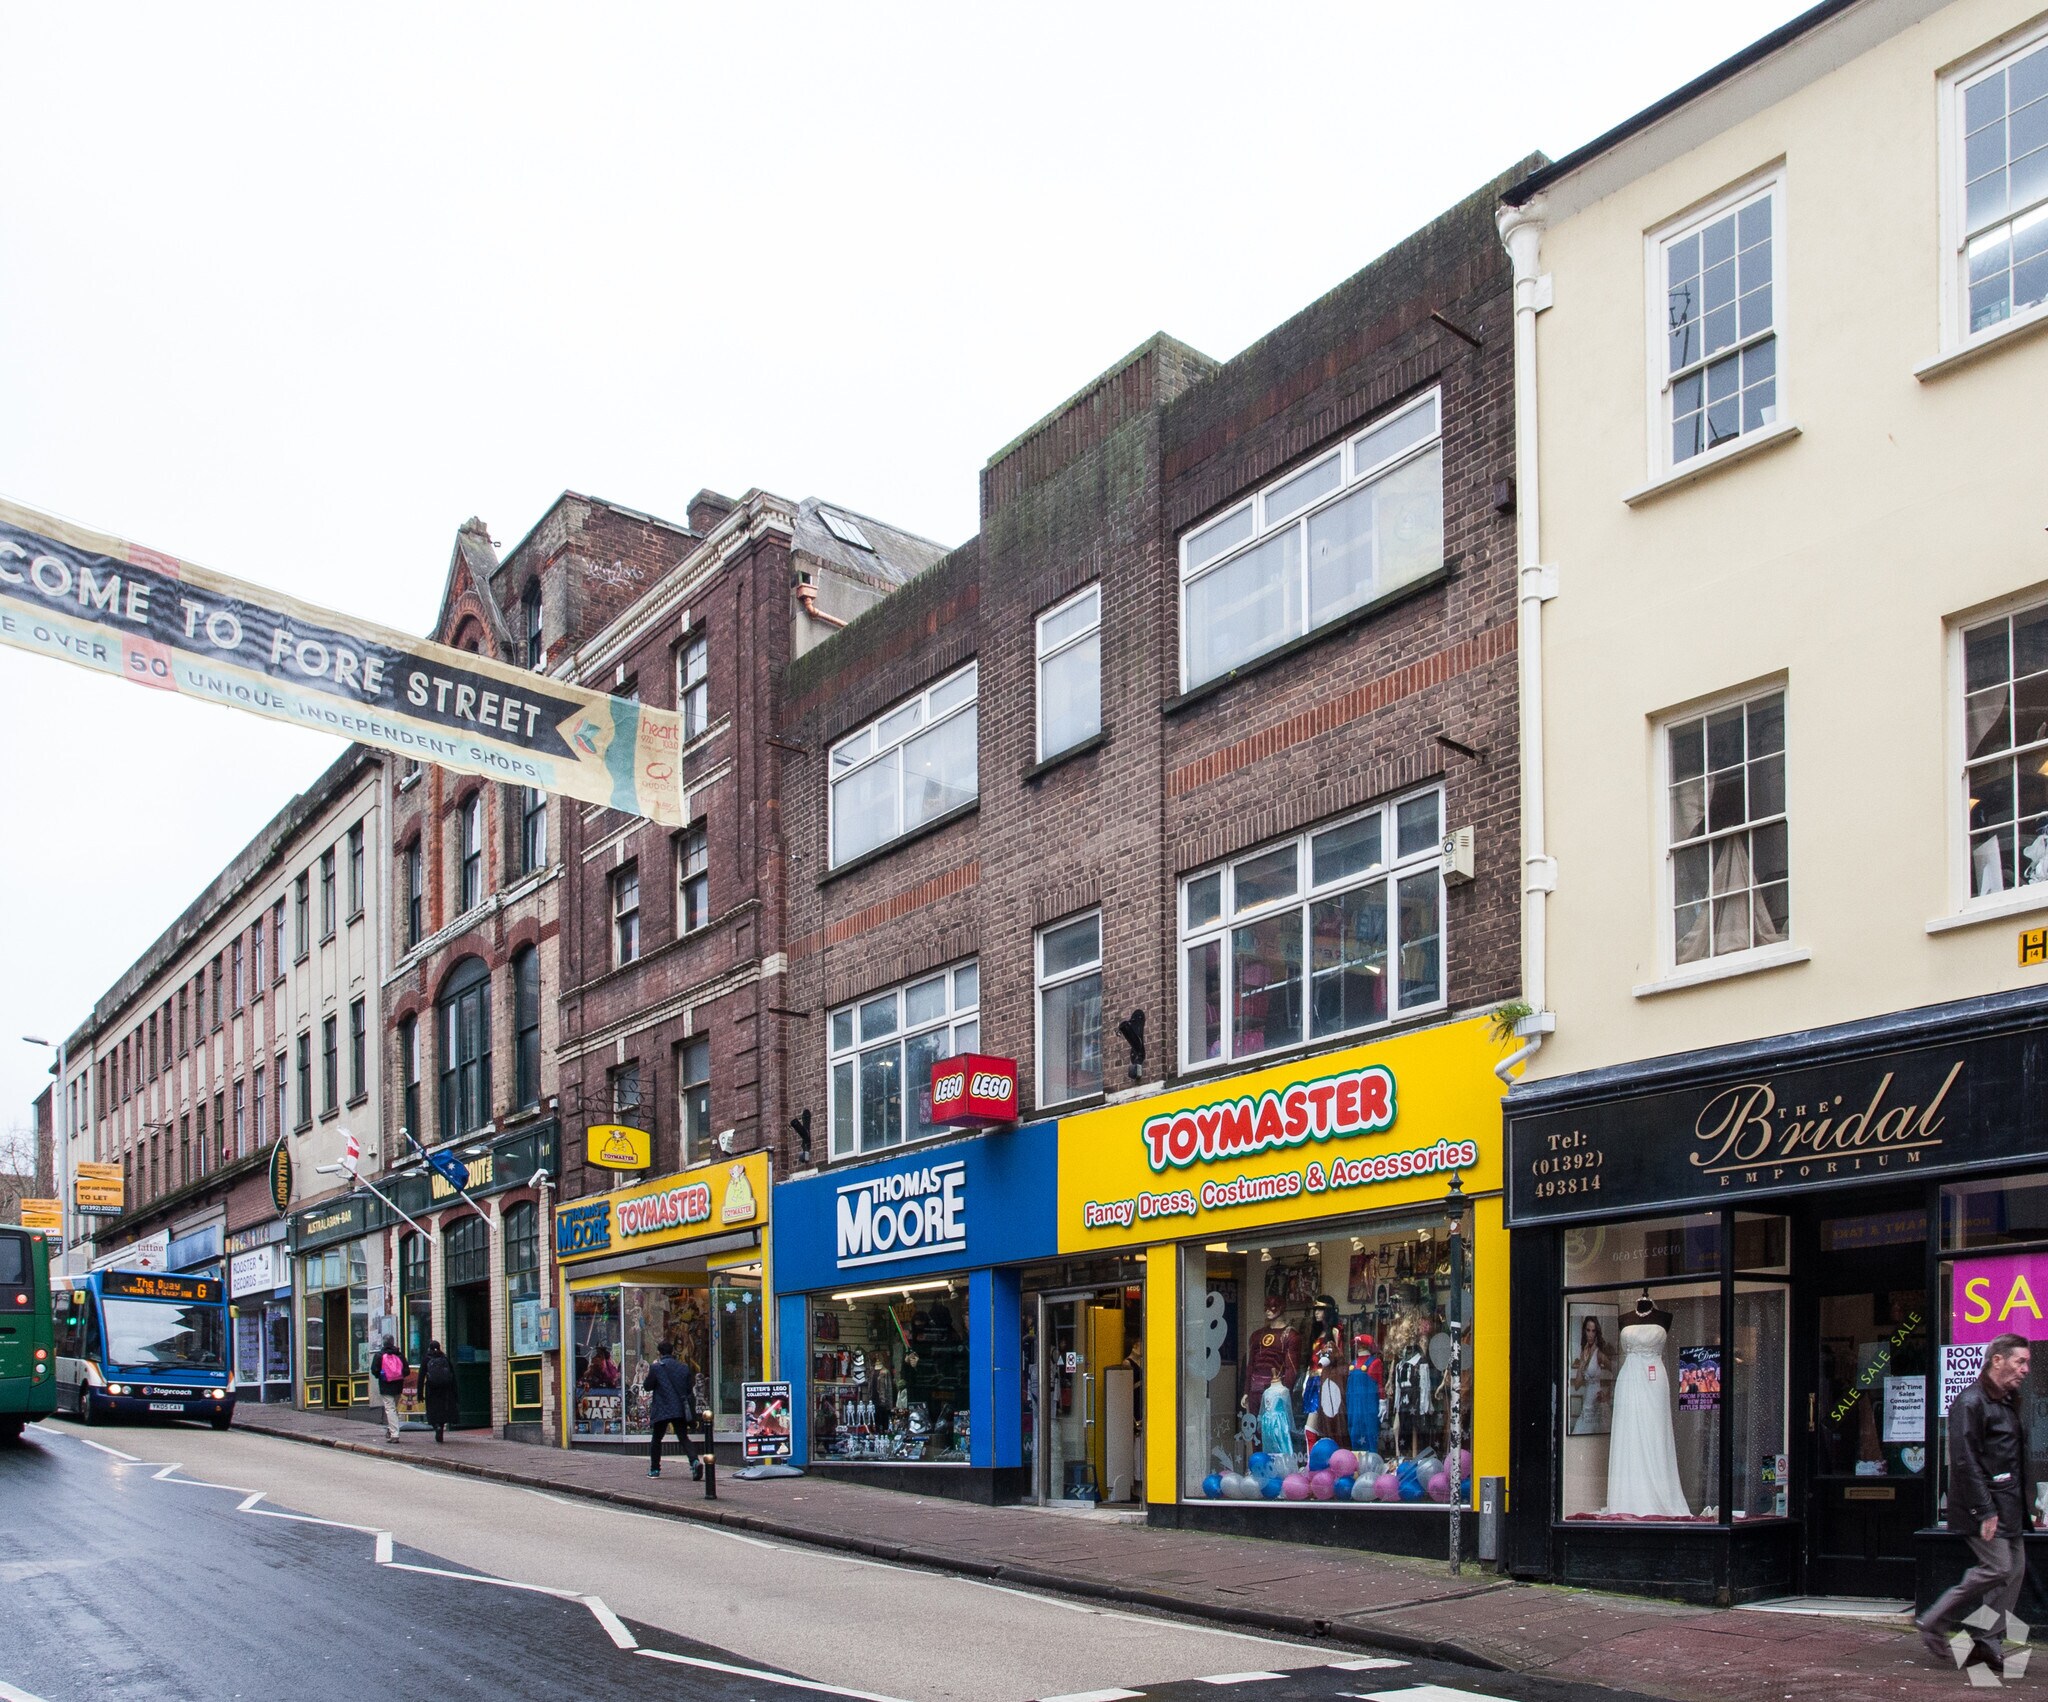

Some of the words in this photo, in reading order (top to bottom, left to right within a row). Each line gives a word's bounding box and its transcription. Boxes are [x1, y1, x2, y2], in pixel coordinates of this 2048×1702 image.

[0, 541, 151, 624] COME
[180, 598, 243, 650] TO
[270, 628, 385, 694] FORE
[407, 671, 541, 737] STREET
[33, 627, 108, 662] OVER
[130, 651, 168, 678] 50
[188, 671, 285, 709] UNIQUE
[298, 703, 457, 756] INDEPENDENT
[470, 748, 537, 776] SHOPS
[641, 716, 679, 740] heart
[2022, 930, 2047, 963] H
[2032, 935, 2038, 943] 6
[2030, 949, 2039, 958] 14
[935, 1074, 964, 1103] LEGO
[971, 1074, 1012, 1099] LEGO
[1146, 1073, 1389, 1166] TOYMASTER
[1689, 1061, 1964, 1166] Bridal
[1778, 1101, 1829, 1118] THE
[1547, 1130, 1587, 1150] Tel:
[604, 1153, 635, 1162] TOYMASTER
[1532, 1150, 1603, 1176] (01392)
[1720, 1151, 1920, 1186] EMPORIUM
[277, 1151, 288, 1206] WALKABOUT
[869, 1165, 943, 1204] THOMAS
[1086, 1202, 1133, 1228] Fancy
[1139, 1192, 1195, 1218] Dress,
[1203, 1174, 1299, 1205] Costumes
[1307, 1165, 1324, 1188] &
[1332, 1142, 1475, 1184] Accessories
[1535, 1174, 1601, 1198] 493814
[569, 1202, 602, 1221] THOMAS
[617, 1186, 710, 1233] TOYMASTER
[724, 1206, 752, 1216] TOYMASTER
[837, 1170, 966, 1257] MOORE
[557, 1205, 611, 1250] MOORE
[233, 1257, 256, 1274] ROOSTER
[136, 1277, 154, 1288] The
[157, 1279, 181, 1290] Quay
[197, 1283, 207, 1298] G
[233, 1274, 256, 1291] RECORDS
[1964, 1274, 2044, 1323] SA
[1946, 1346, 1982, 1358] BOOK
[1946, 1358, 1983, 1370] NOW
[1831, 1387, 1861, 1422] SALE
[1860, 1350, 1891, 1385] SALE
[1891, 1311, 1922, 1347] SALE
[153, 1387, 192, 1396] Stagecoach
[583, 1396, 621, 1408] TAR
[1486, 1503, 1491, 1511] 7
